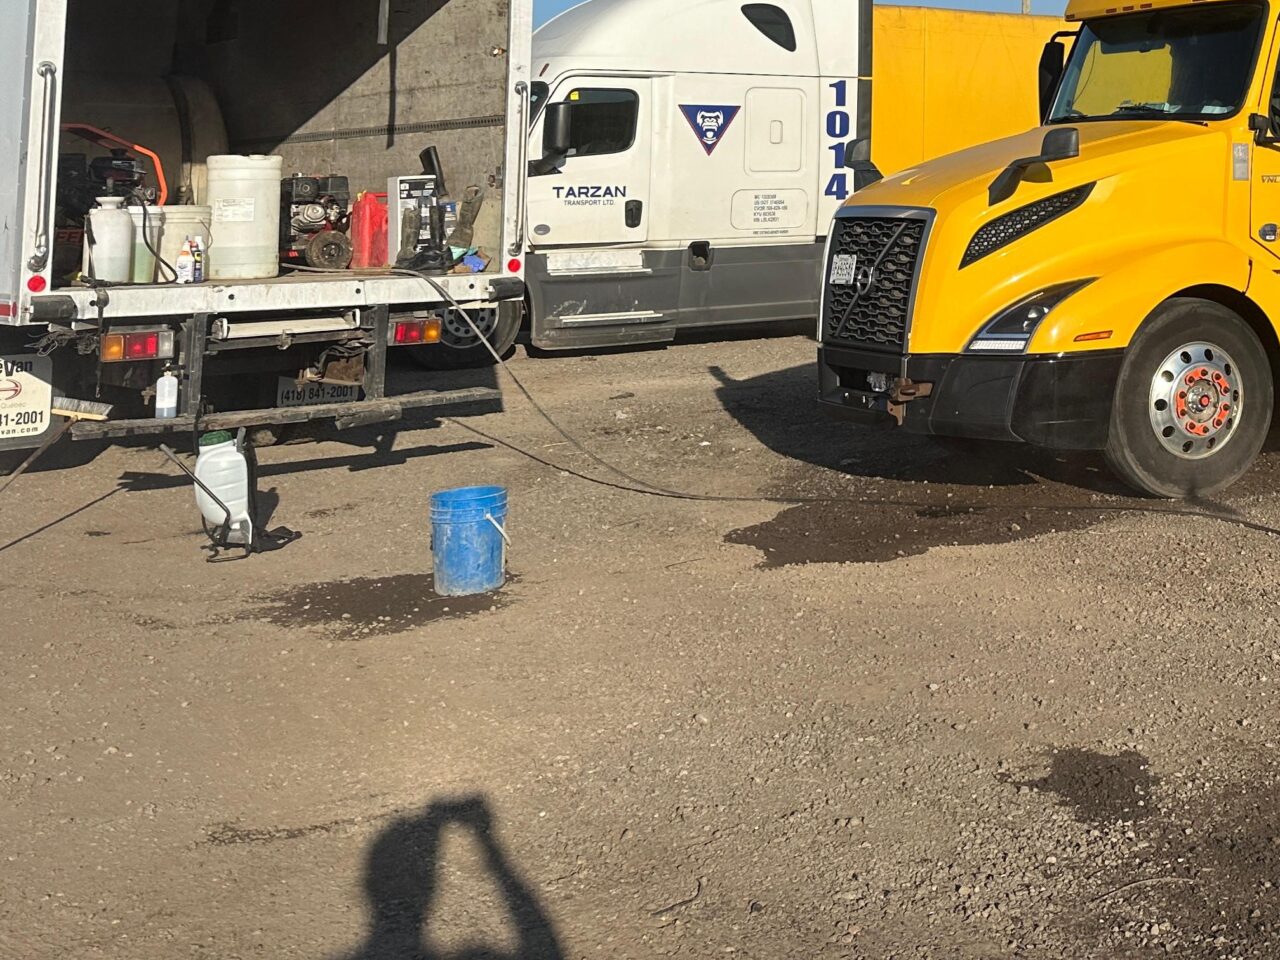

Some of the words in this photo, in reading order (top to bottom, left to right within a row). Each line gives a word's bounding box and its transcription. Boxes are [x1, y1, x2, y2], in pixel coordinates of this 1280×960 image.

[824, 80, 850, 201] 1014
[552, 186, 626, 198] TARZAN
[308, 385, 354, 400] 841-2001
